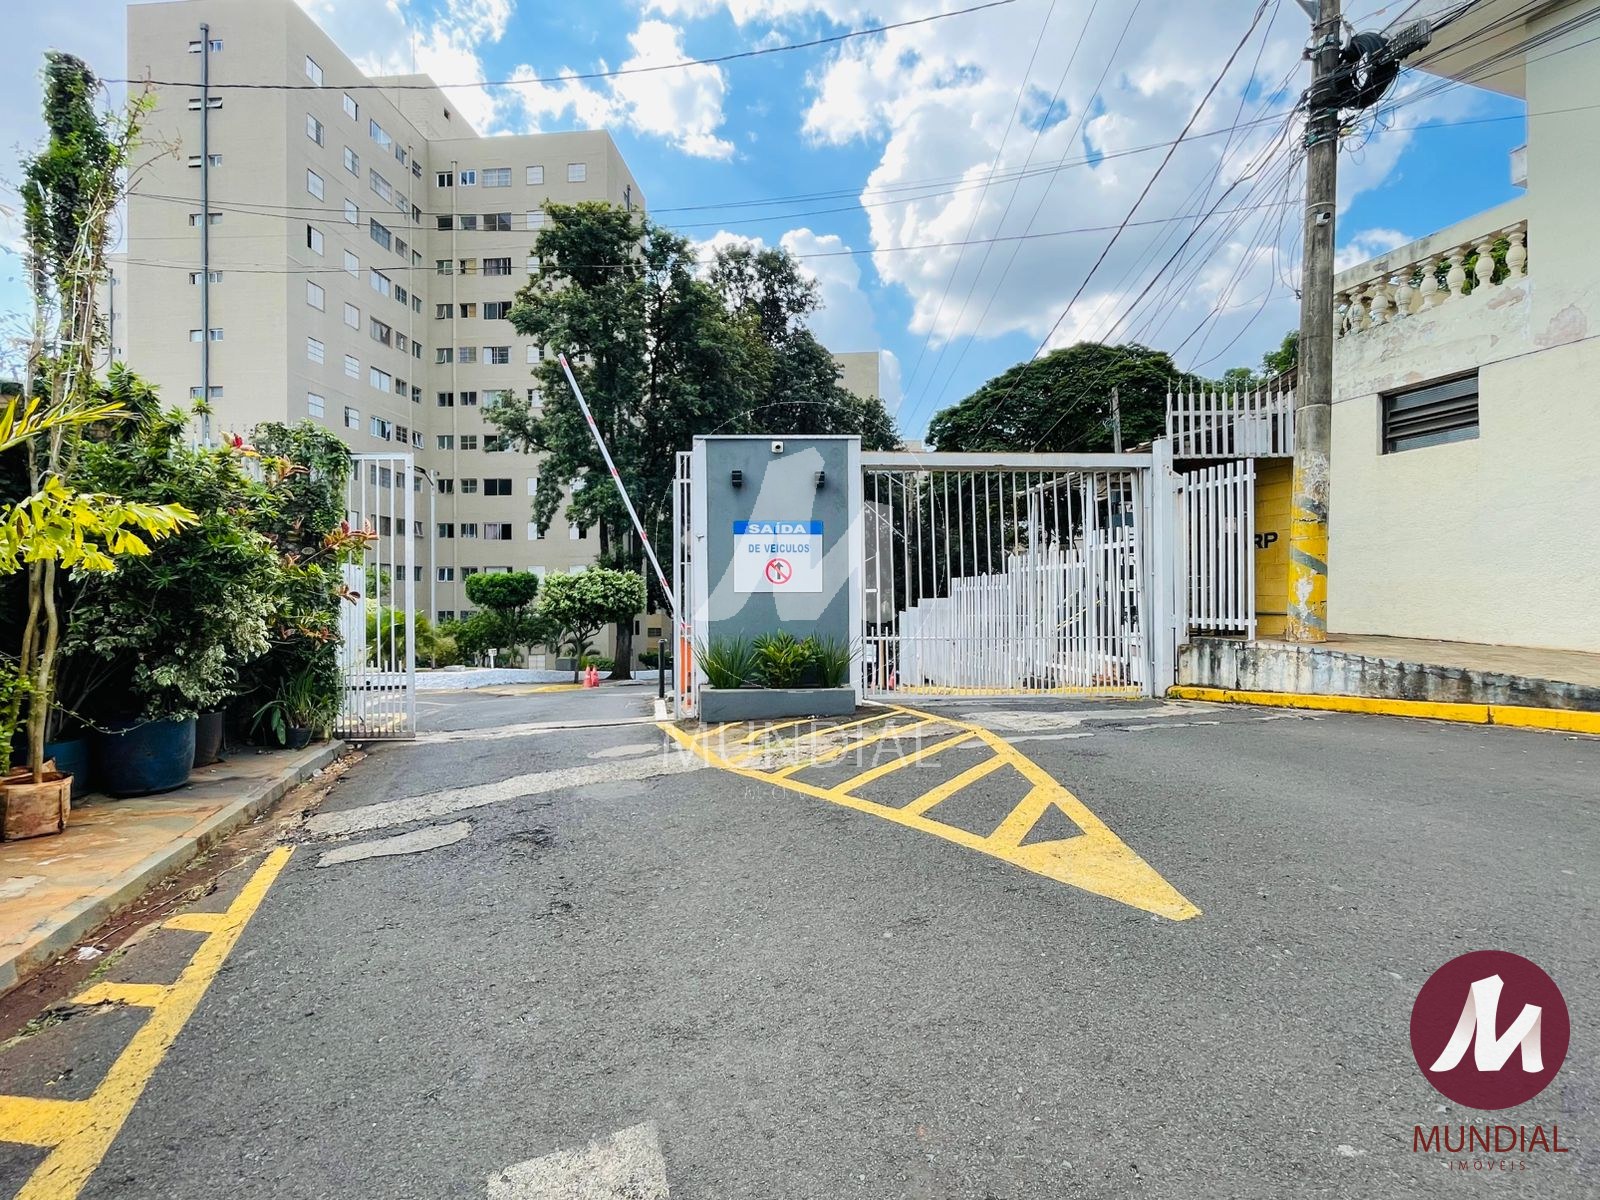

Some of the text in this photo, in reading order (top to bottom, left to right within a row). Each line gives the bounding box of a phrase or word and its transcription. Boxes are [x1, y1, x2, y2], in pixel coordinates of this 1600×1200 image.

[748, 522, 806, 534] SAÍDA
[1254, 532, 1279, 549] RP
[748, 544, 761, 553] DE
